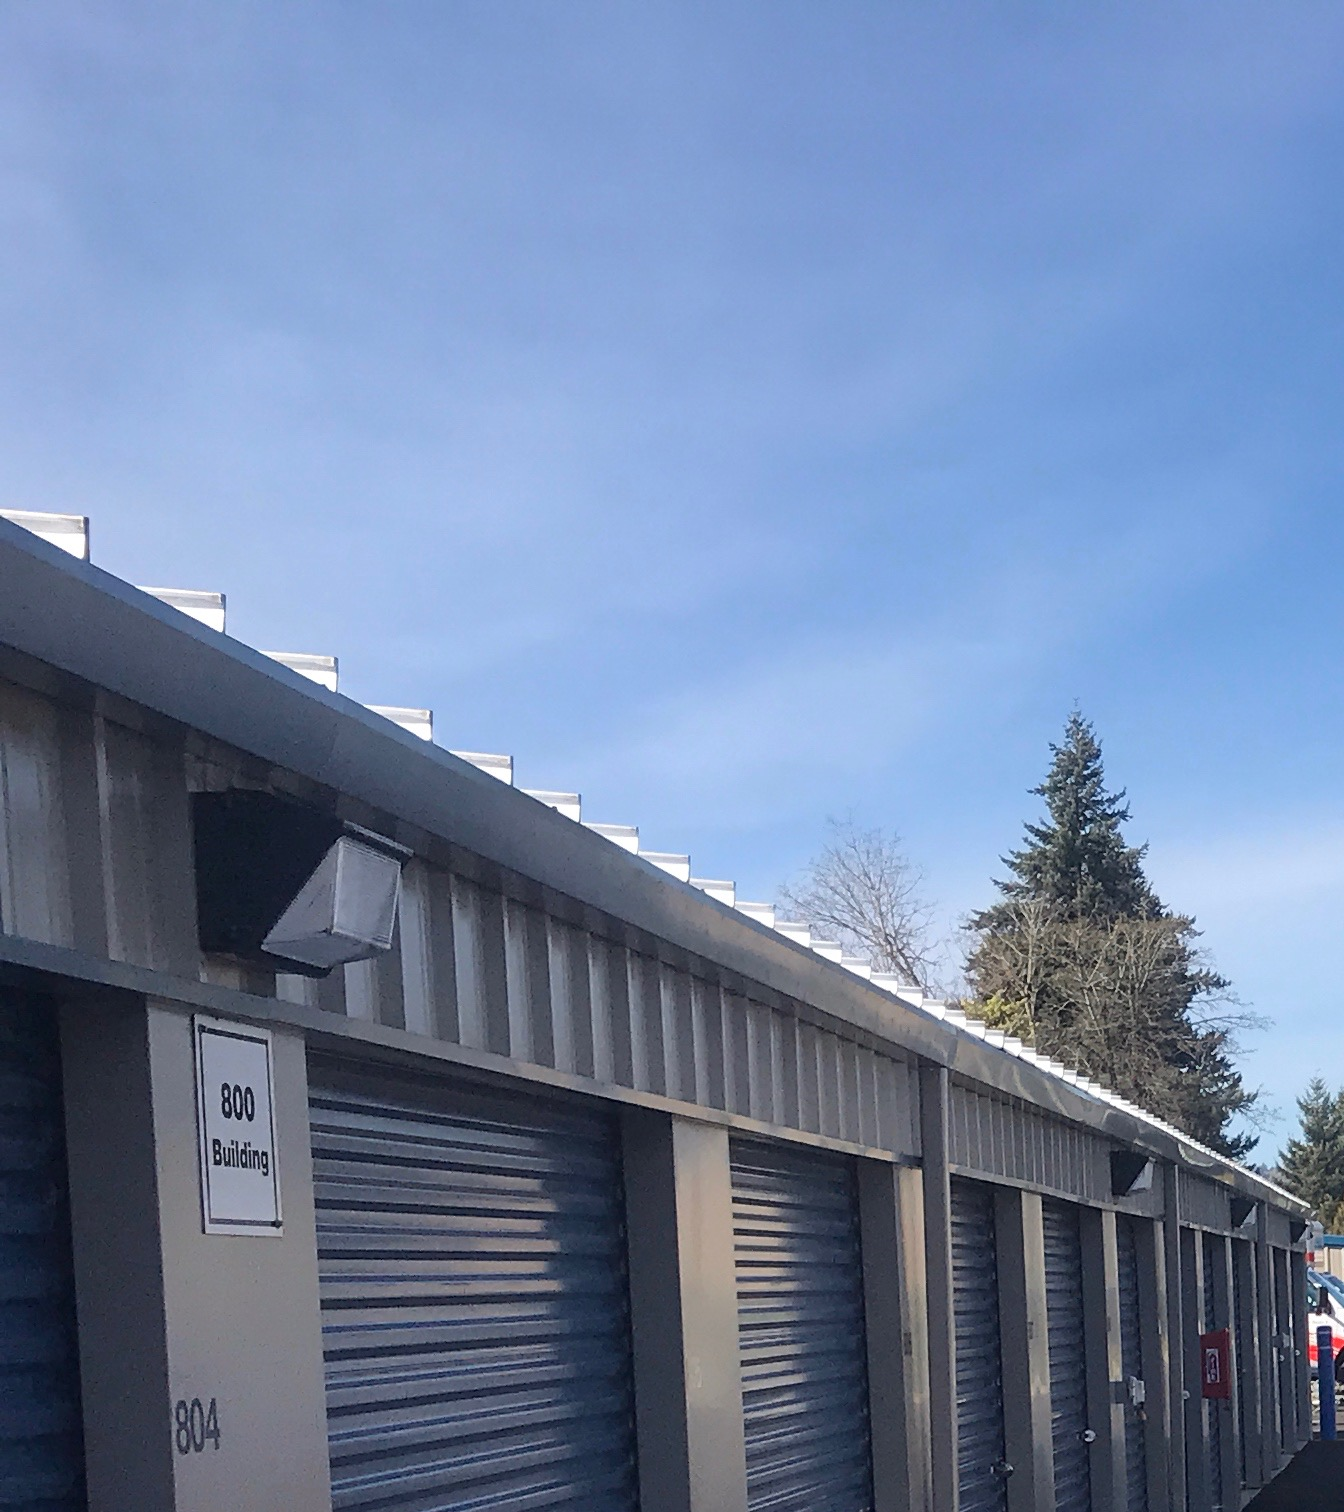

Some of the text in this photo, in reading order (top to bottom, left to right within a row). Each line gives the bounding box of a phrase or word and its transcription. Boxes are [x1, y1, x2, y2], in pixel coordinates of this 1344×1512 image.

[221, 1082, 256, 1122] 800
[212, 1138, 269, 1176] Building
[176, 1397, 220, 1455] 804
